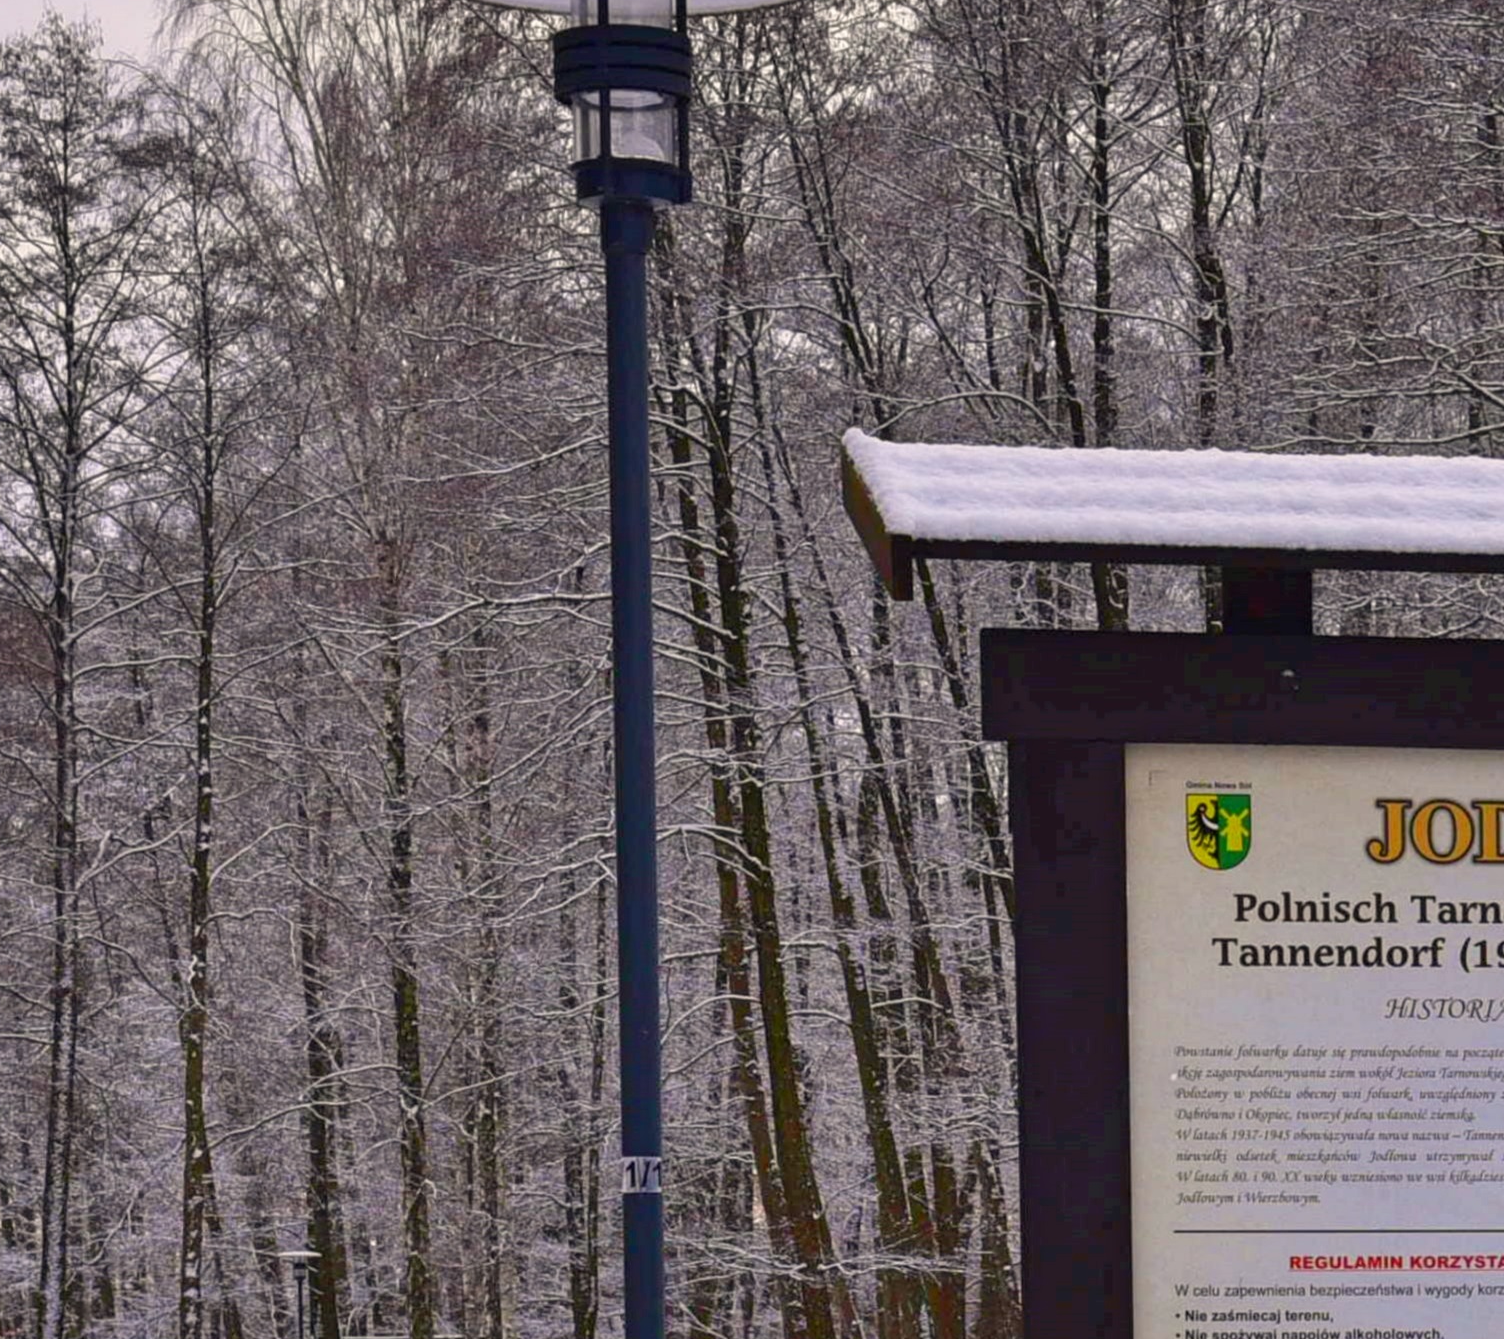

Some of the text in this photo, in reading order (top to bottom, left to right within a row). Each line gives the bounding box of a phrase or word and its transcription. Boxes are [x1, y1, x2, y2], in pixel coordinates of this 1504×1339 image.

[1233, 892, 1398, 923] Polnisch
[1212, 937, 1446, 968] Tannendorf
[1232, 1128, 1290, 1141] 1937-1945
[626, 1161, 661, 1188] 1/1
[1289, 1255, 1403, 1269] REGULAMIN
[1174, 1284, 1189, 1297] W
[1192, 1283, 1220, 1296] celu
[1223, 1283, 1306, 1300] zapewnienia
[1309, 1283, 1414, 1300] bezpieczeństwa
[1425, 1282, 1474, 1299] wygody
[1185, 1308, 1334, 1325] Nie zaśmiecaj terenu,
